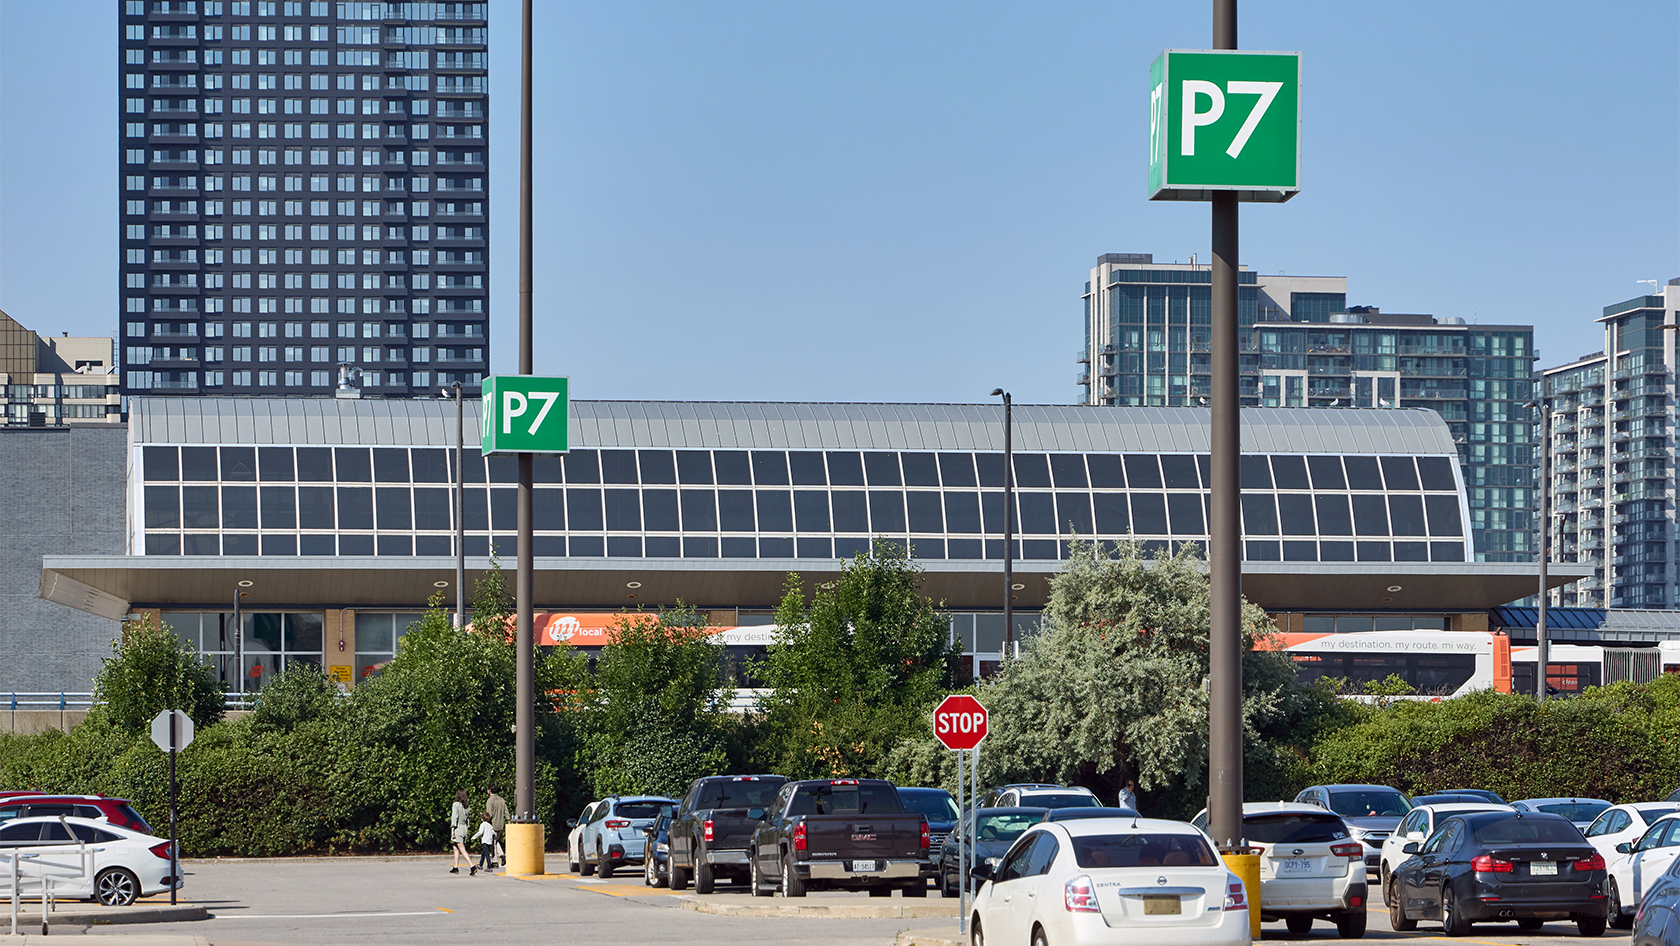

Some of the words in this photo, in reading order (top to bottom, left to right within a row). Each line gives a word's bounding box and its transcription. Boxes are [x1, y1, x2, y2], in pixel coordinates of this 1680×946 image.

[1150, 82, 1163, 166] P7
[1181, 80, 1284, 159] P7
[482, 391, 492, 438] P7
[503, 391, 560, 436] P7
[579, 628, 602, 636] local
[727, 634, 741, 642] my
[1321, 641, 1336, 649] my
[1338, 640, 1393, 649] destination.
[1395, 641, 1410, 650] my
[1412, 641, 1439, 649] route.
[1442, 641, 1453, 649] mi
[1456, 642, 1477, 650] way.
[938, 712, 984, 733] STOP
